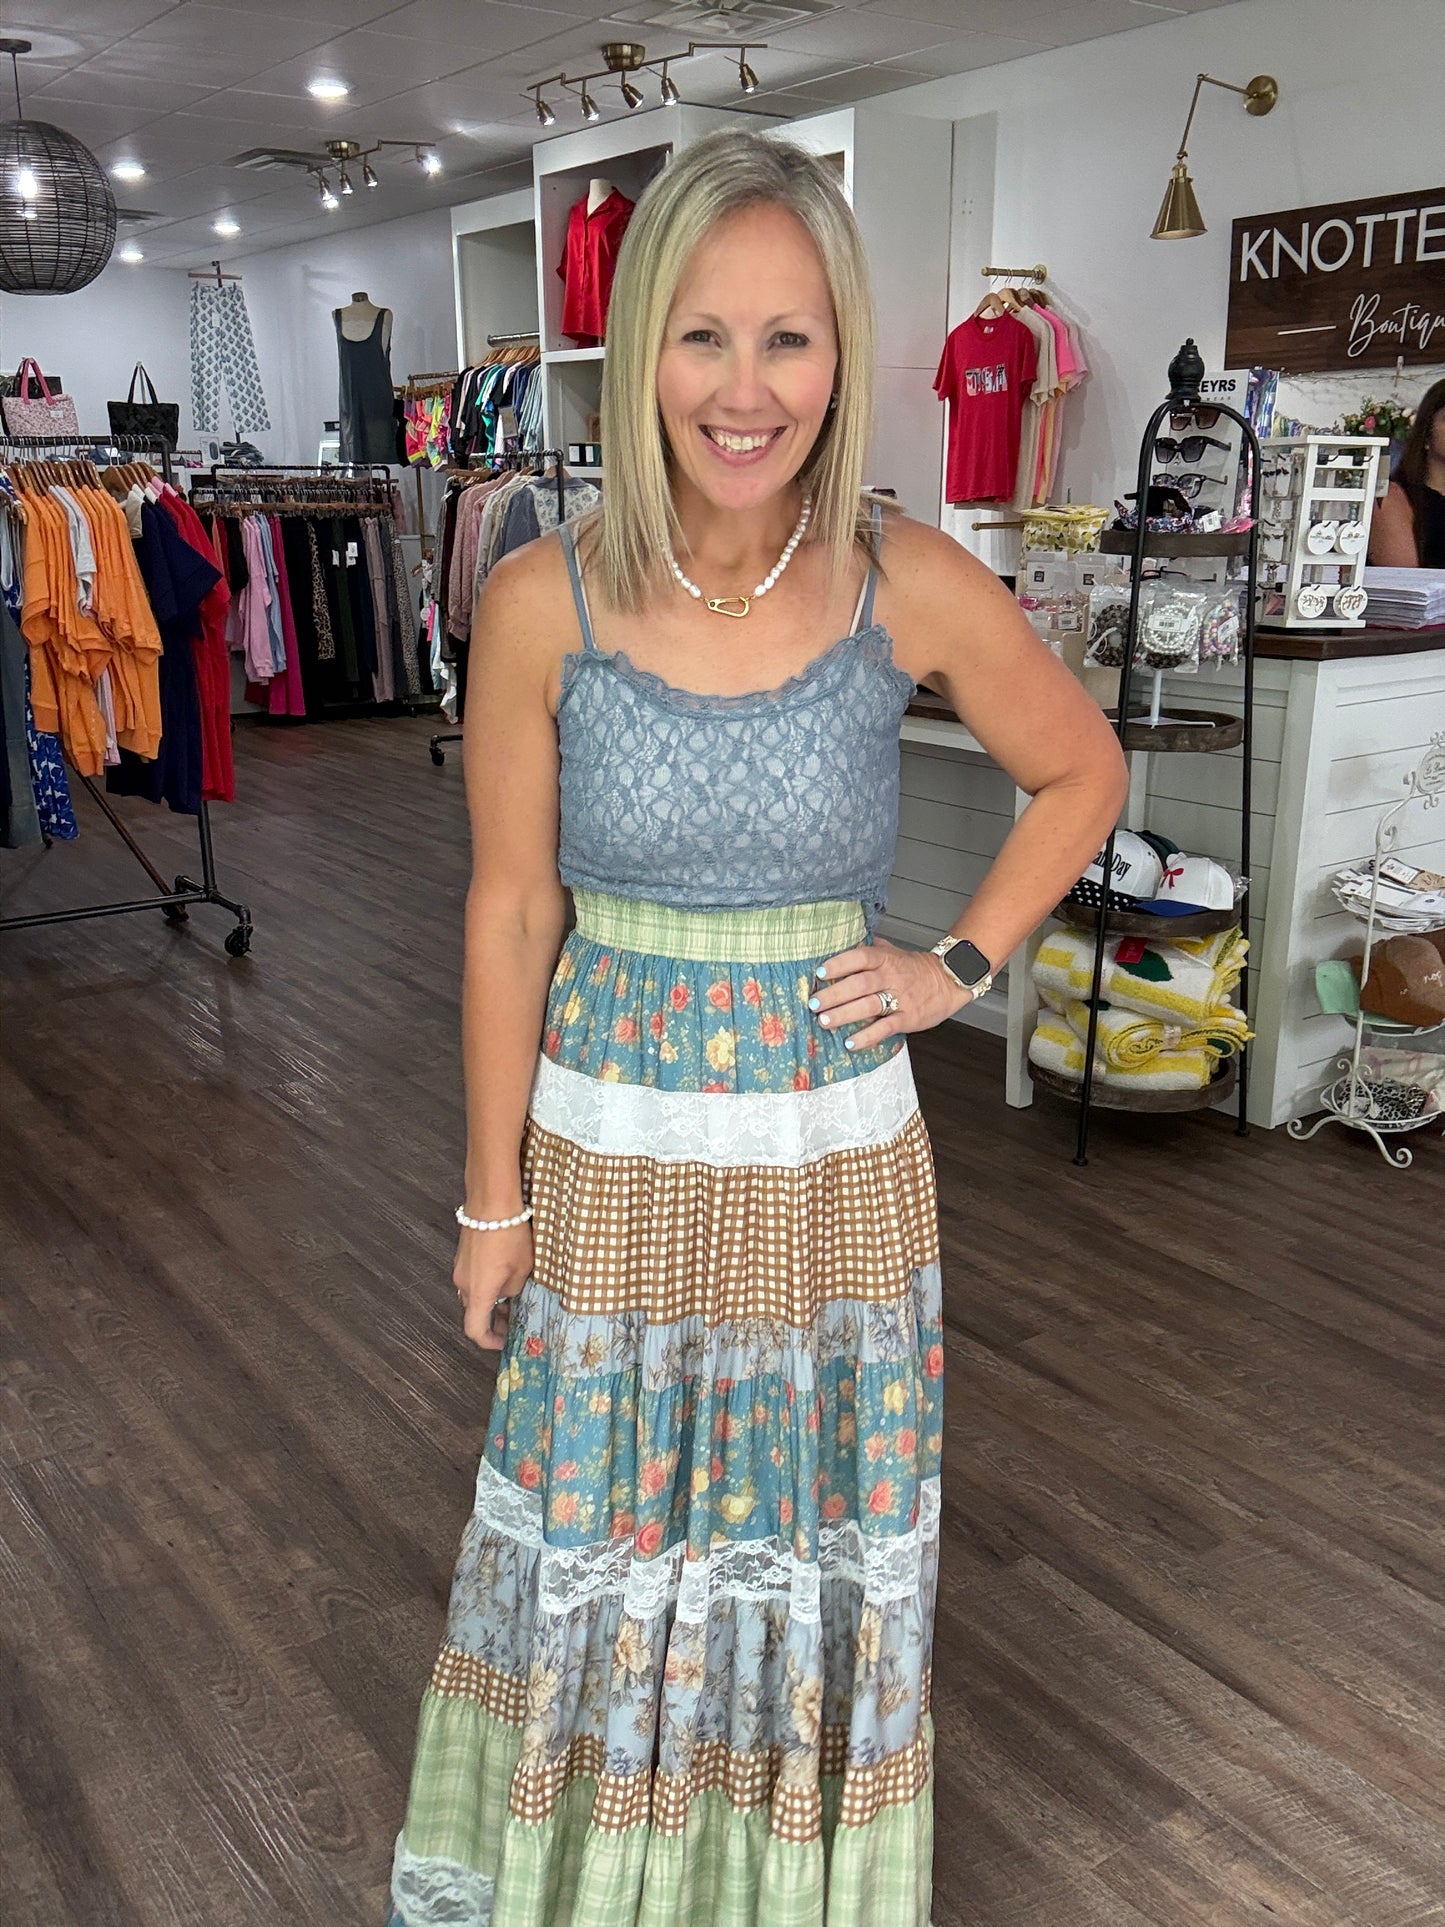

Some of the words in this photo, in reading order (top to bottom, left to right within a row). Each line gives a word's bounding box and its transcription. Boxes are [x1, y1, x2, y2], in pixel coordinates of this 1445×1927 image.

[1240, 205, 1445, 282] KNOTTE
[1197, 378, 1237, 393] EYRS
[1110, 852, 1132, 881] Day
